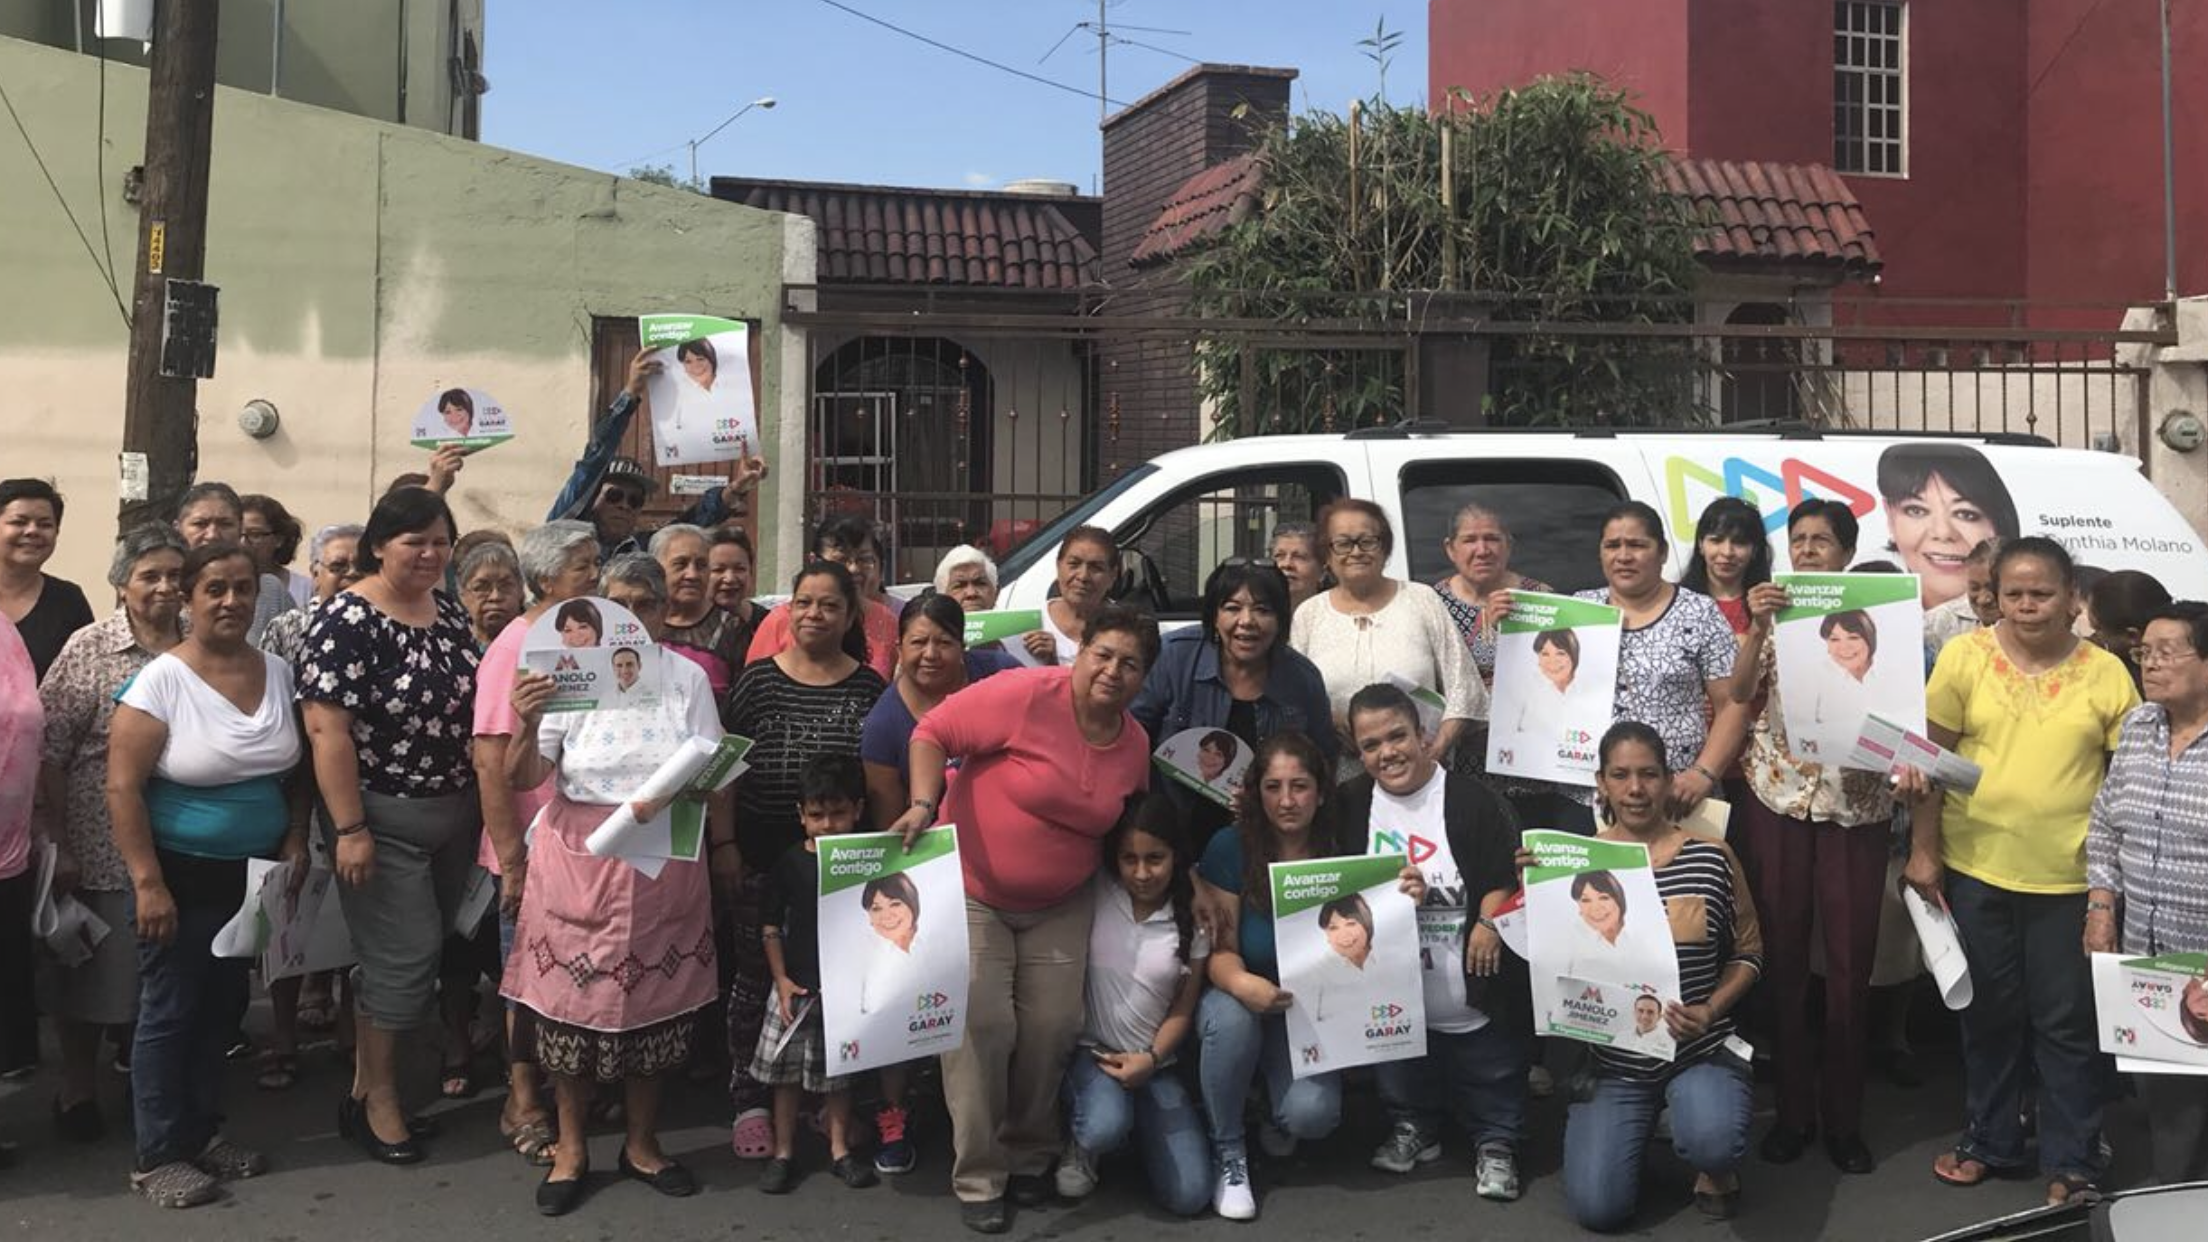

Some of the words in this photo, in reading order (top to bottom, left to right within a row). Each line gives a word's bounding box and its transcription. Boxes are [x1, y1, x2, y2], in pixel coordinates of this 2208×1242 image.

[649, 331, 691, 341] contigo
[2039, 514, 2113, 529] Suplente
[2045, 532, 2118, 551] ynthia
[2122, 536, 2193, 554] Molano
[1784, 583, 1846, 596] Avanzar
[1793, 596, 1843, 610] ontigo
[552, 672, 597, 683] ANOLO
[1557, 750, 1596, 762] GARAY
[830, 847, 887, 861] Avanzar
[1535, 842, 1589, 856] Avanzar
[830, 861, 882, 876] contigo
[1283, 872, 1341, 887] Avanzar
[1283, 884, 1339, 901] contigo
[1562, 999, 1618, 1019] MANOLO
[909, 1015, 954, 1032] GARAY
[1365, 1024, 1411, 1039] GARAY
